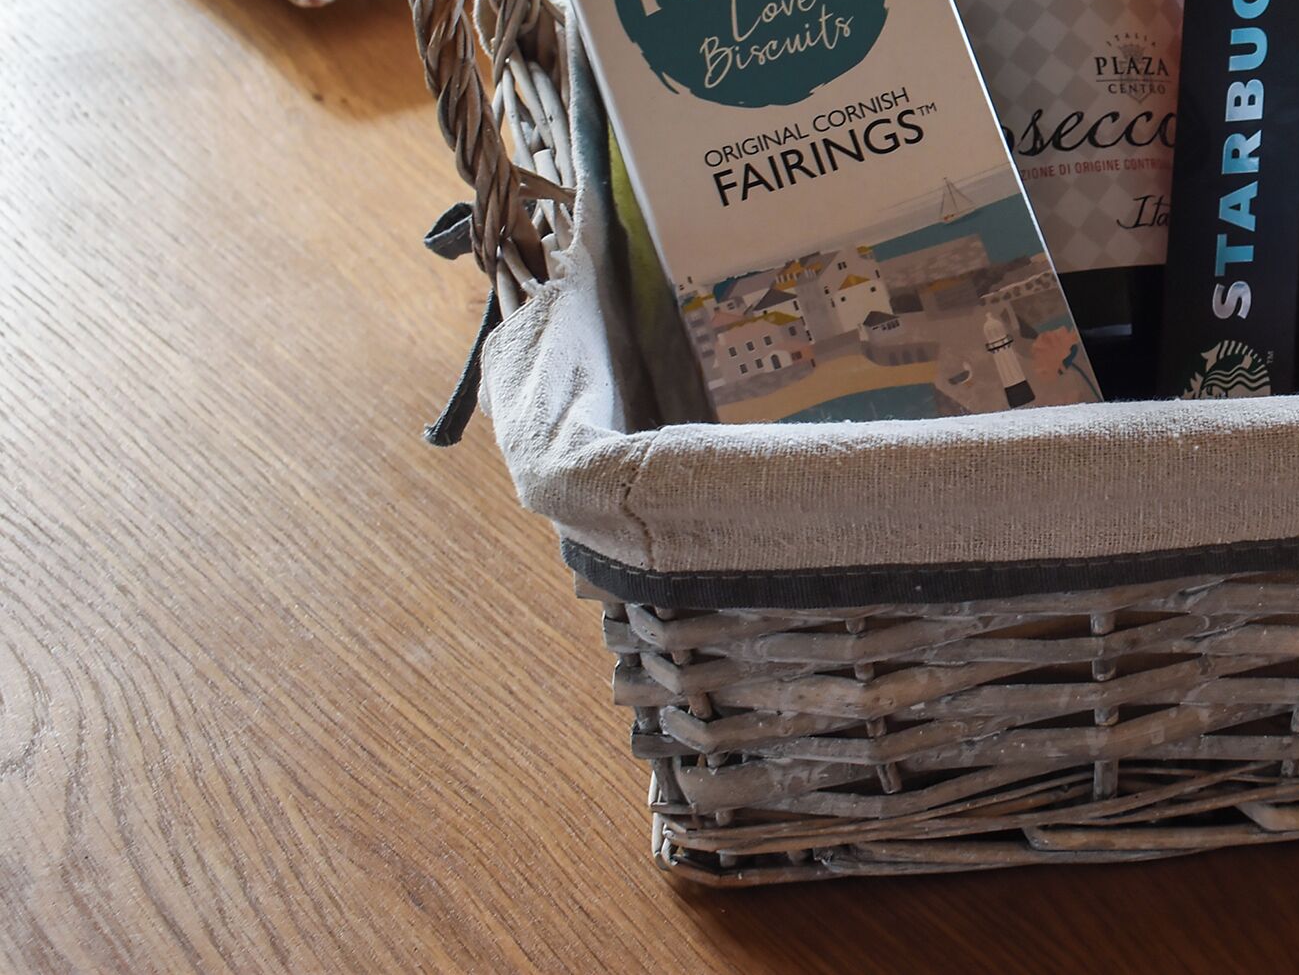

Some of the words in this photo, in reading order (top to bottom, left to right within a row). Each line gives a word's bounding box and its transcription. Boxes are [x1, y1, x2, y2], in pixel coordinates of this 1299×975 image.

[699, 3, 855, 89] Biscuits
[1094, 56, 1170, 76] PLAZA
[1107, 83, 1167, 95] CENTRO
[704, 122, 811, 168] ORIGINAL
[812, 86, 911, 133] CORNISH
[1059, 163, 1071, 175] DI
[1074, 160, 1121, 174] ORIGINE
